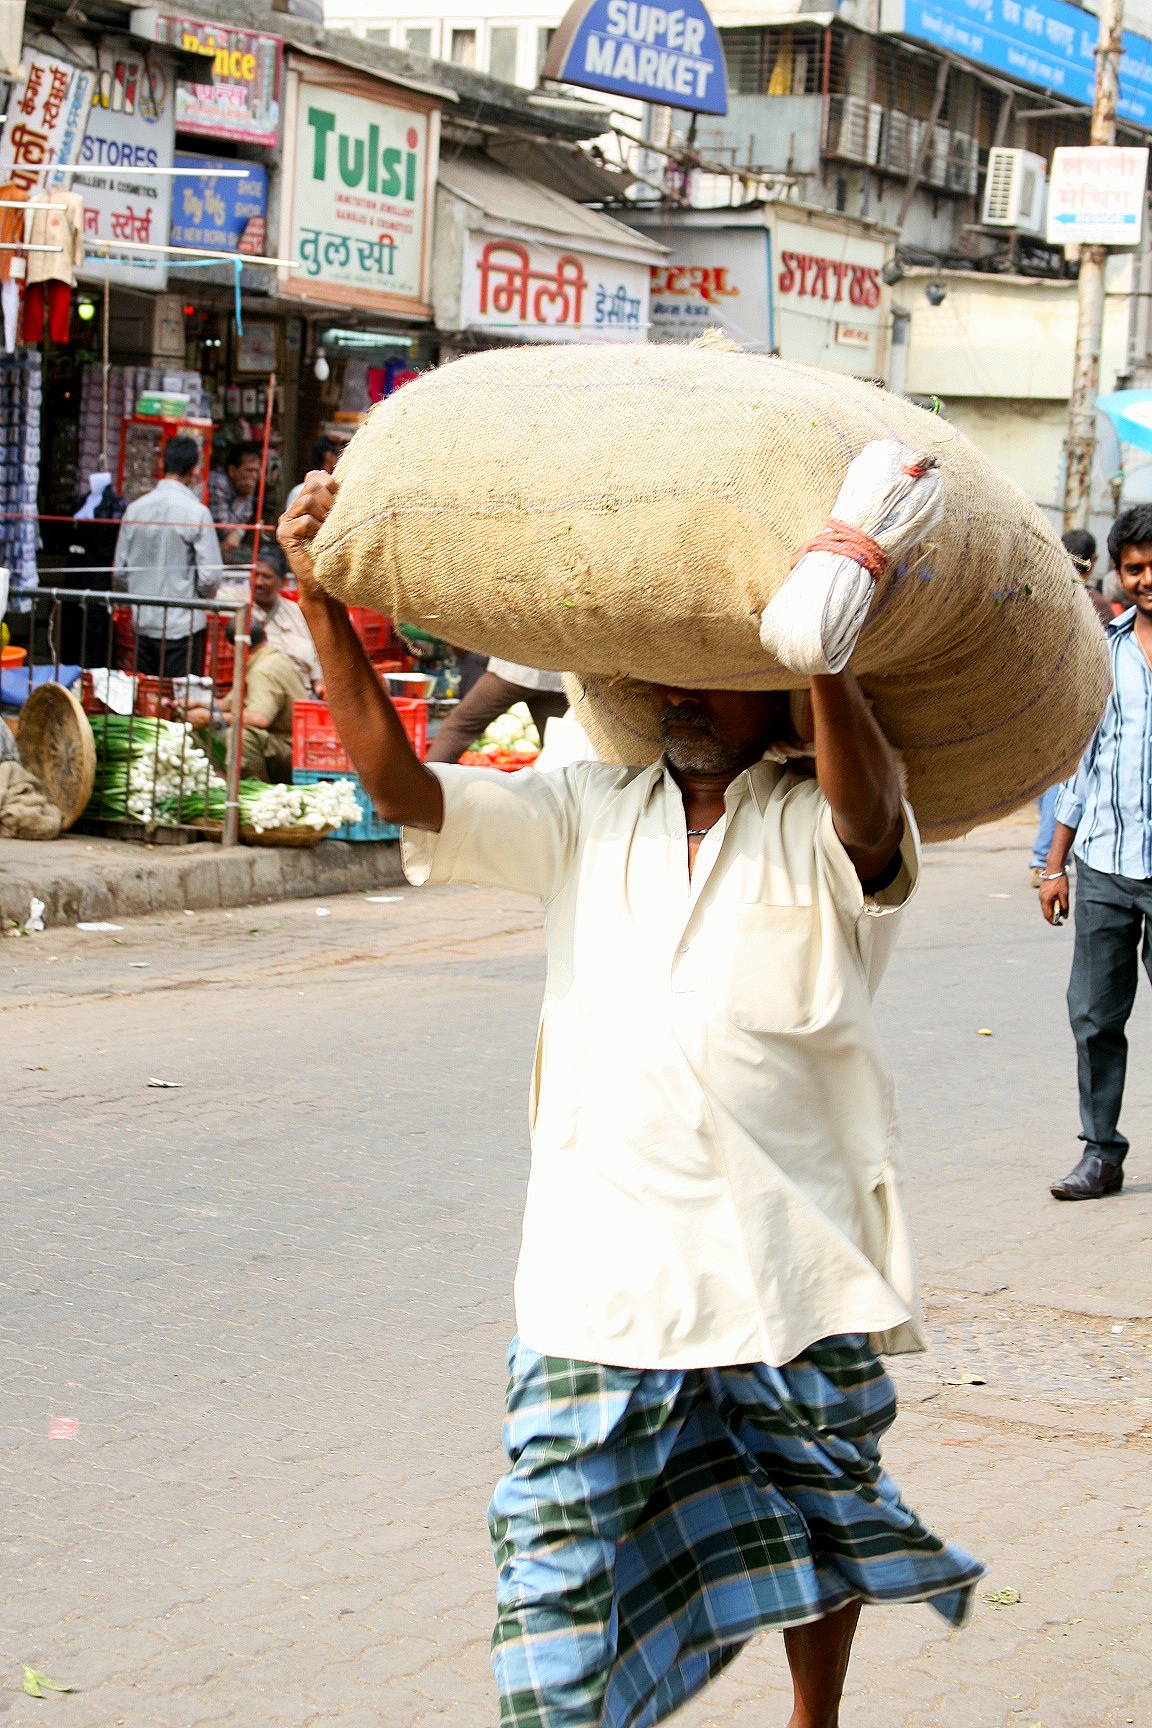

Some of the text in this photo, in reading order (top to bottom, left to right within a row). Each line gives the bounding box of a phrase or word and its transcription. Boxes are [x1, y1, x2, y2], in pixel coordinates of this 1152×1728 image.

[606, 1, 705, 56] SUPER
[585, 35, 714, 99] MARKET
[82, 135, 158, 168] STORES
[308, 106, 417, 200] Tulsi
[300, 228, 398, 276] तुलसी
[779, 251, 881, 309] STATUS
[477, 241, 588, 325] मिली
